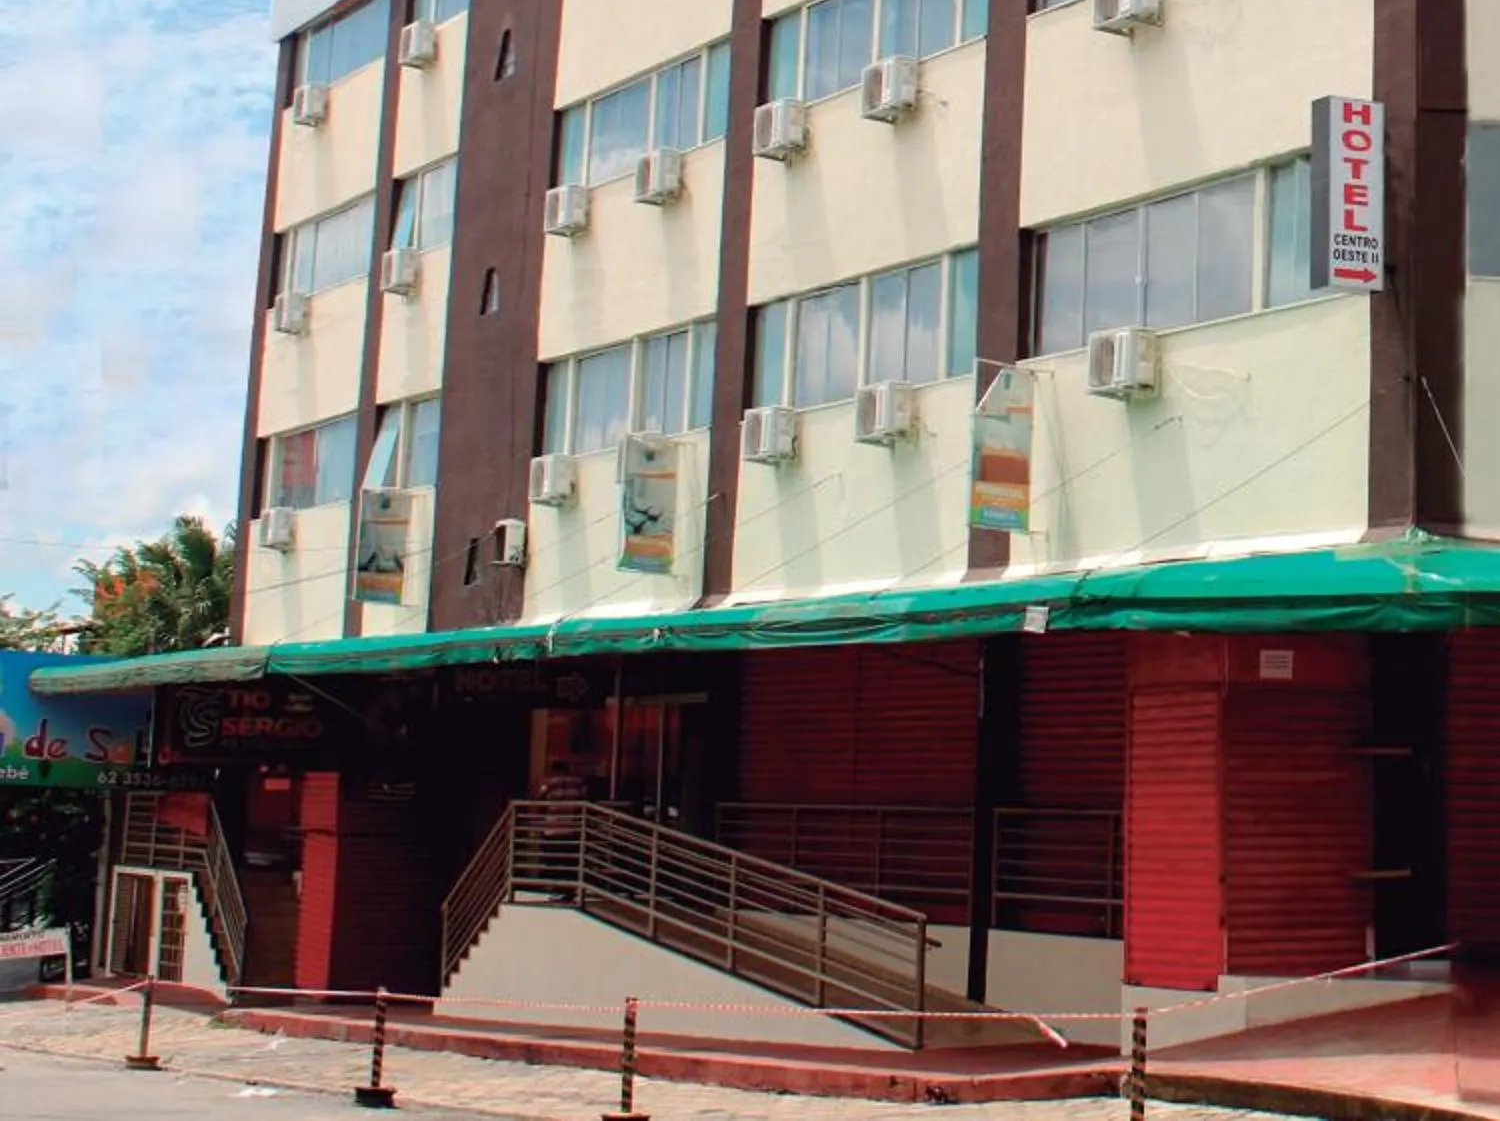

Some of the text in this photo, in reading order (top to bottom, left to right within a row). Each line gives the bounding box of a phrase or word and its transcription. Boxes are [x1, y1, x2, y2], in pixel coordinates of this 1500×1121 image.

[1342, 102, 1373, 232] HOTEL
[1333, 233, 1379, 250] CENTRO
[1333, 249, 1369, 264] OESTE
[225, 688, 271, 709] TIO
[23, 718, 70, 760] de
